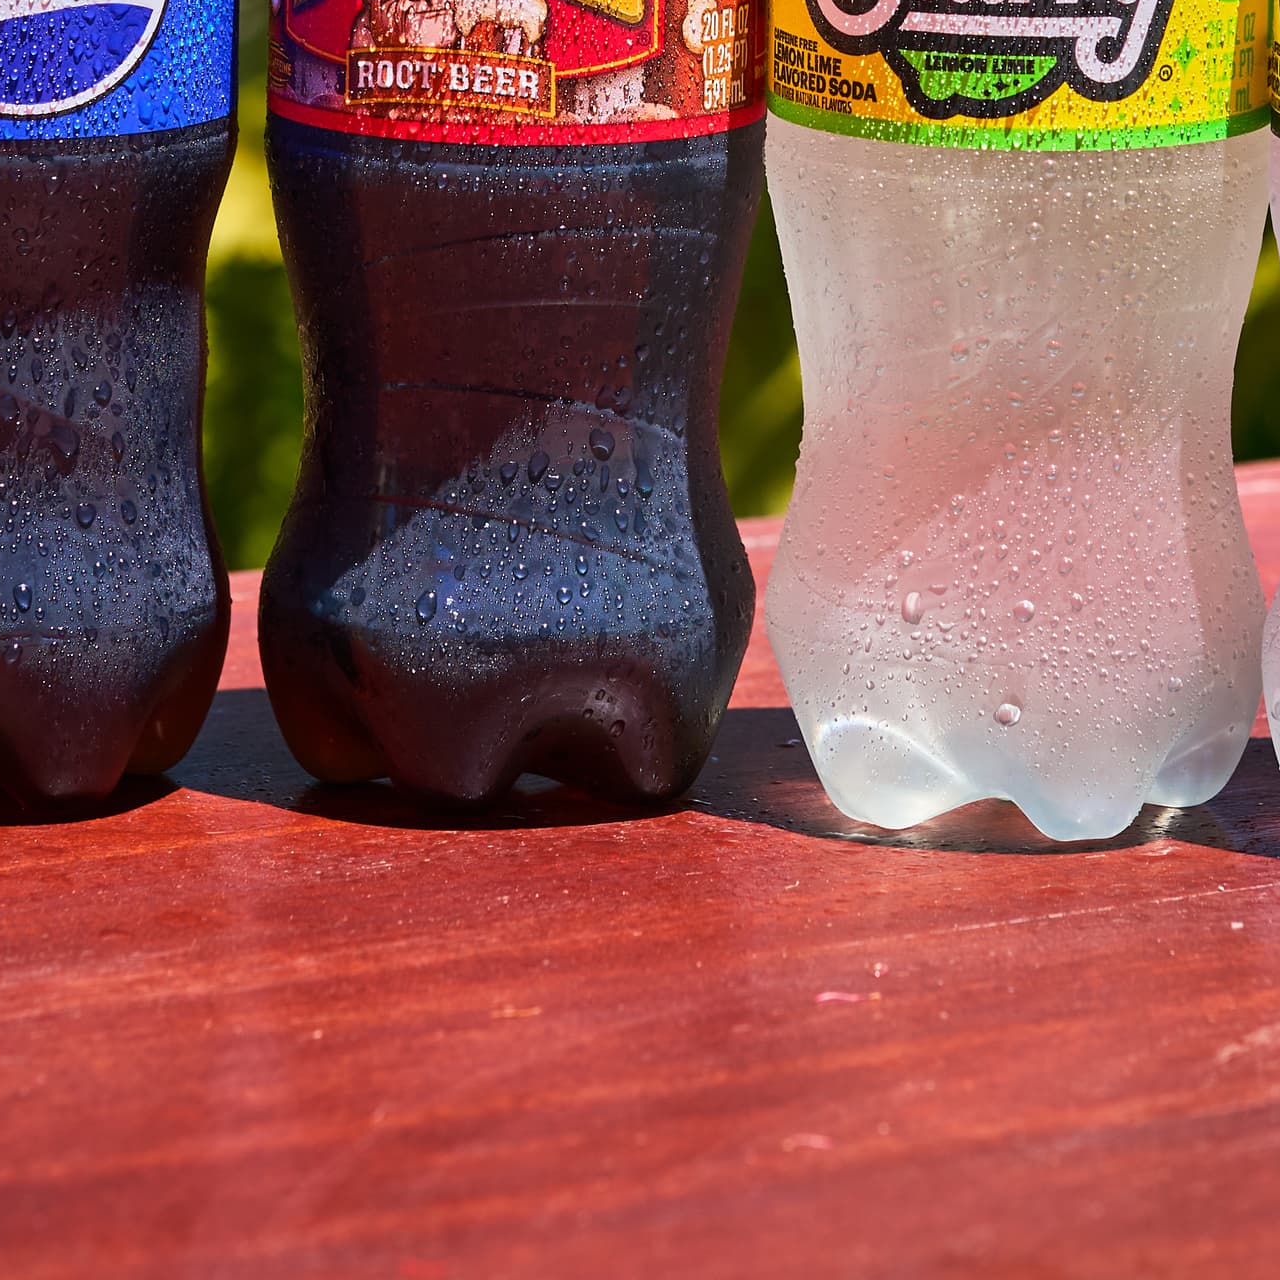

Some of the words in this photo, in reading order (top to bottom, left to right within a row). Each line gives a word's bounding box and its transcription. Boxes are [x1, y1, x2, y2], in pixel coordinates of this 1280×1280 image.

[703, 10, 719, 42] 20
[721, 7, 735, 39] FL
[737, 3, 750, 35] OZ
[773, 27, 799, 47] CAFFEINE
[799, 37, 819, 53] FREE
[702, 41, 732, 77] (1.25
[733, 38, 748, 70] PT)
[773, 39, 805, 69] LEMON
[806, 52, 842, 77] LIME
[924, 54, 989, 76] LEMON
[992, 55, 1037, 76] LIME
[357, 60, 438, 89] ROOT
[448, 62, 540, 99] BEER
[703, 77, 727, 110] 591
[730, 72, 747, 105] mL
[773, 60, 827, 94] FLAVORED
[828, 78, 878, 103] SODA
